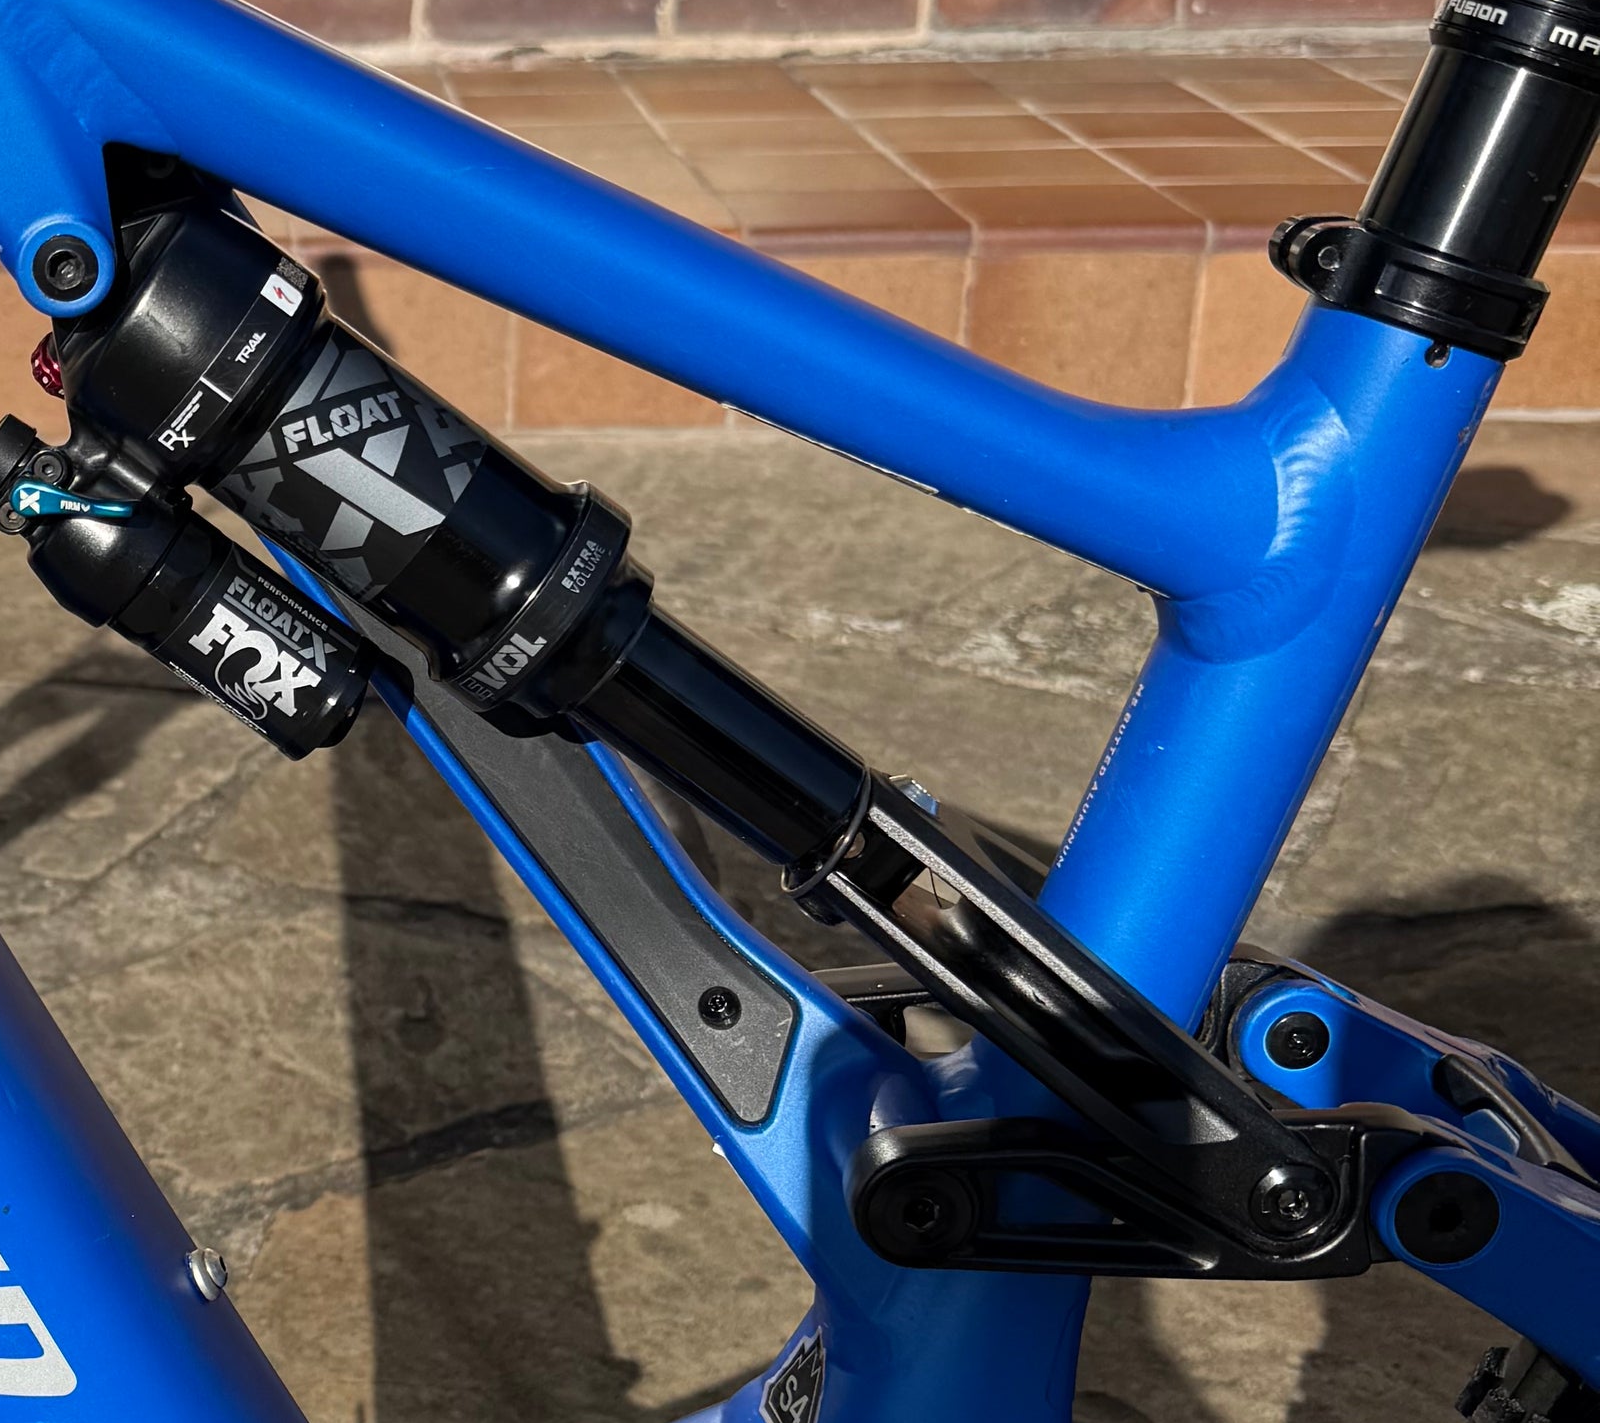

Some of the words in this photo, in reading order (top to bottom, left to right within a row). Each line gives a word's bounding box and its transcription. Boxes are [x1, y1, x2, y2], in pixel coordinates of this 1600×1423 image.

[234, 332, 267, 364] TRAIL
[281, 390, 402, 454] FLOAT
[561, 539, 597, 589] EXTRA
[570, 545, 605, 593] VOLUME
[257, 576, 329, 631] PERFORMANCE
[188, 603, 322, 720] FOX
